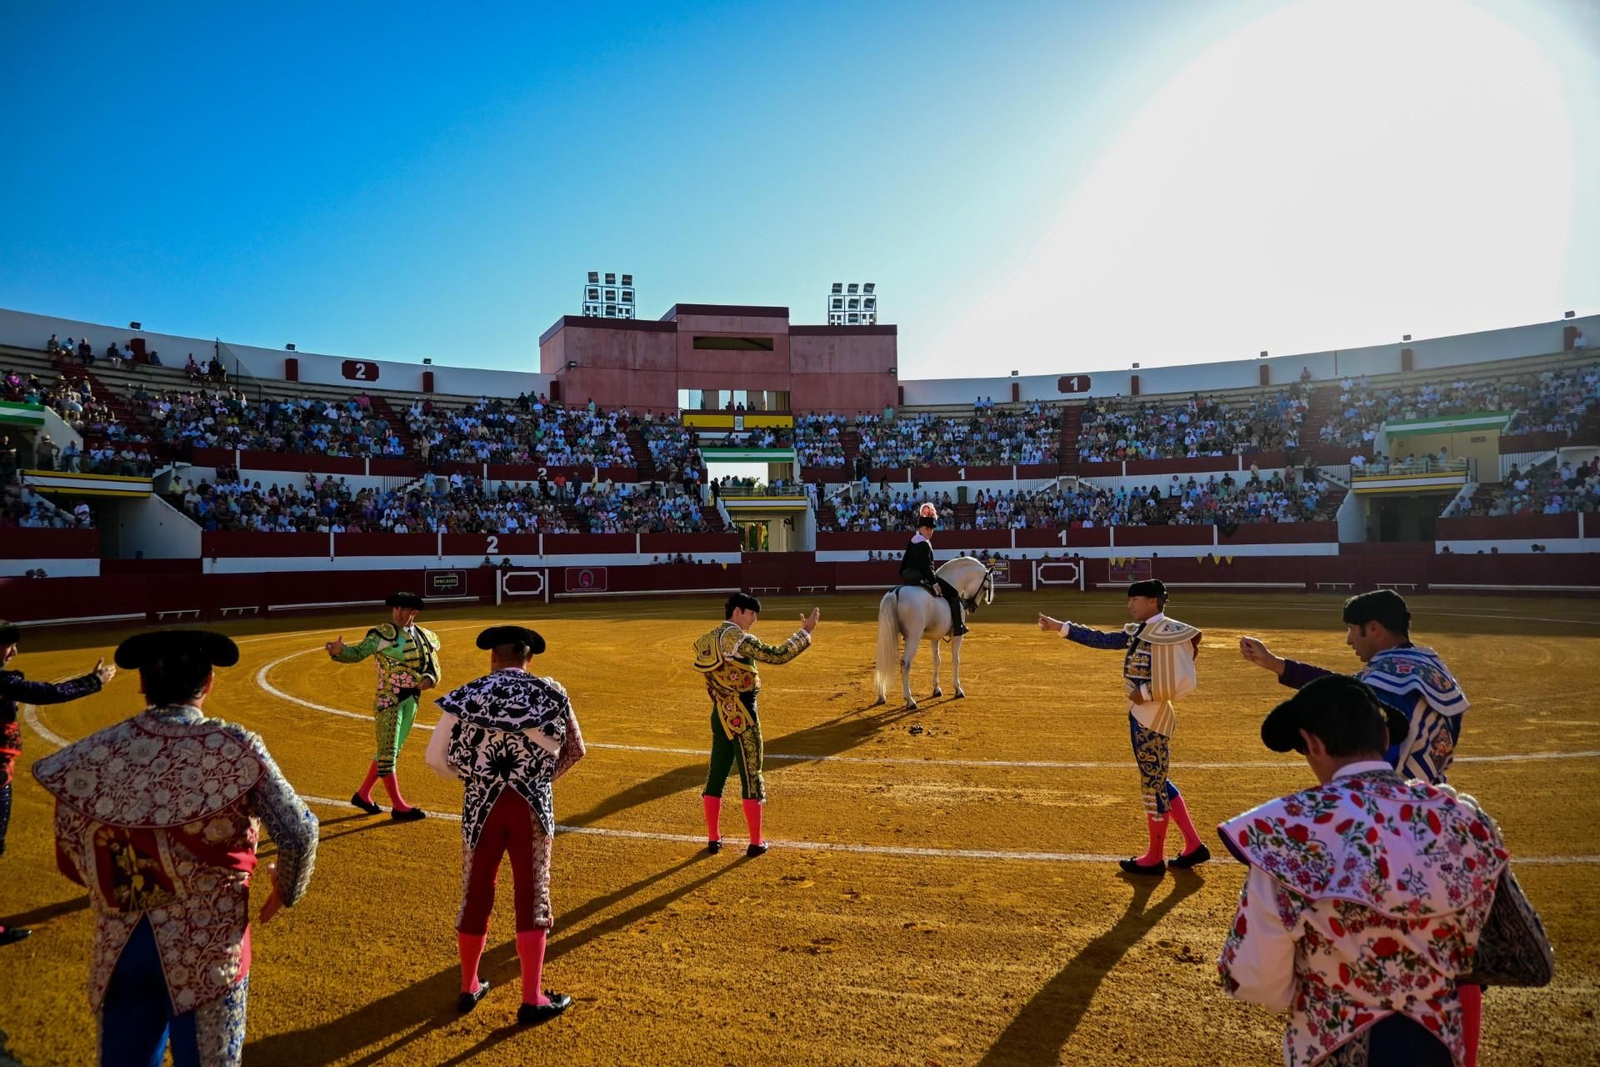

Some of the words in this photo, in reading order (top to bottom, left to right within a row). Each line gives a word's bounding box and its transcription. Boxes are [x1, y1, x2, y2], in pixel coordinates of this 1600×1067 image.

[355, 363, 366, 379] 2
[1070, 377, 1078, 391] 1
[958, 467, 966, 480] 1
[486, 535, 499, 553] 2
[1057, 529, 1067, 546] 1
